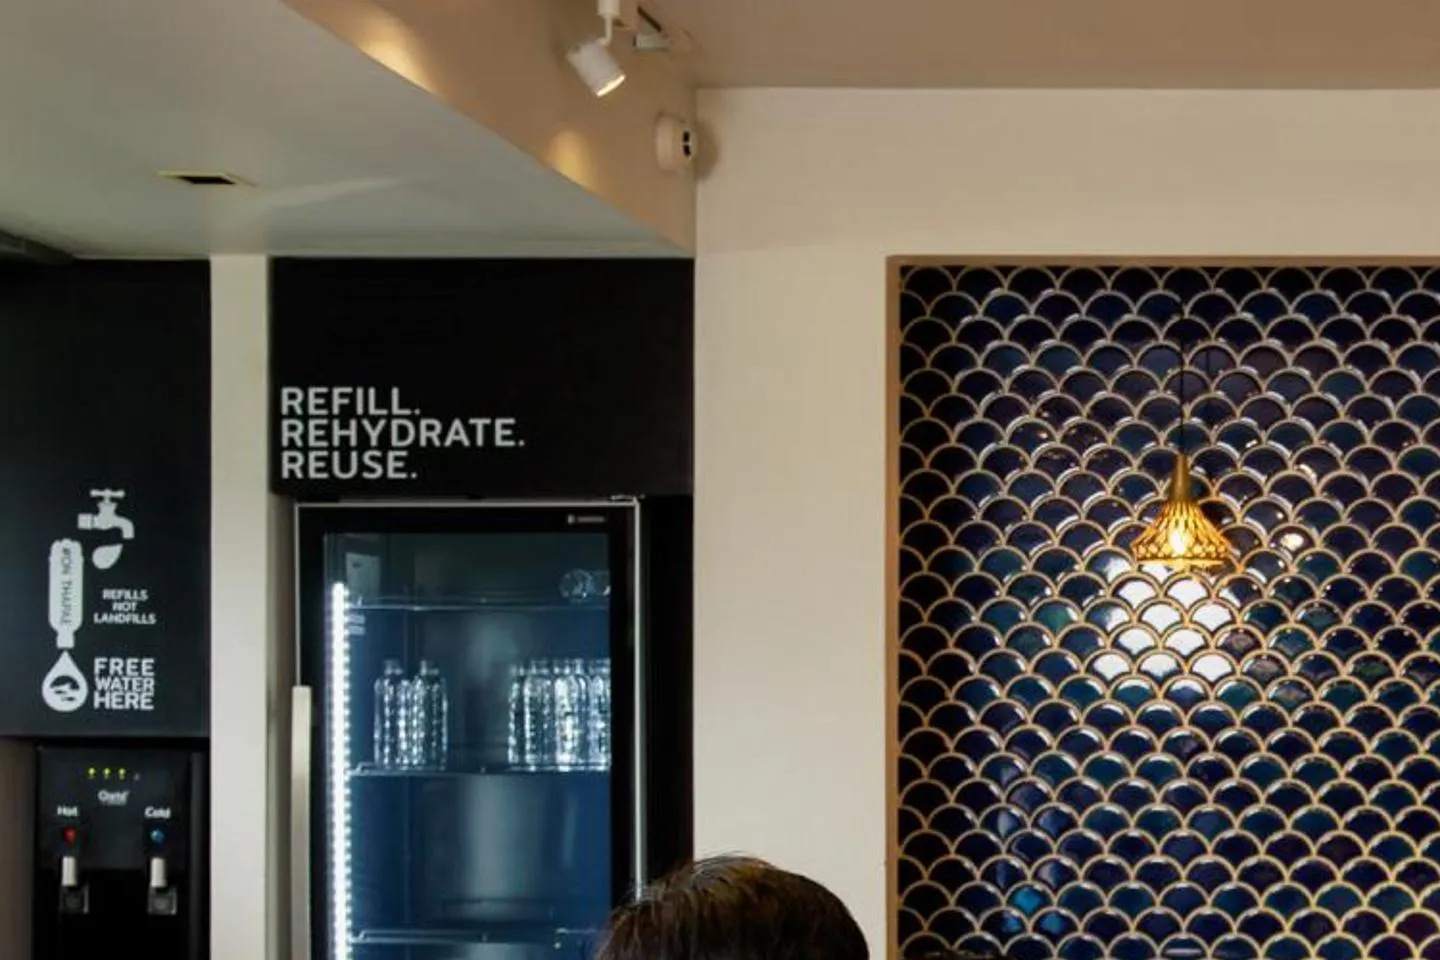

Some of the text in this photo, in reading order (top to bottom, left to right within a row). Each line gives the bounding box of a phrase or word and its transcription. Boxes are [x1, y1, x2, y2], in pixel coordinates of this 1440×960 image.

[281, 386, 421, 416] REFILL.
[281, 418, 525, 448] REHYDRATE.
[281, 450, 417, 479] REUSE.
[102, 589, 149, 601] REFILLS
[112, 601, 138, 612] NOT
[93, 612, 156, 625] LANDFILLS
[93, 658, 155, 677] FREE
[94, 675, 155, 695] WATER
[93, 692, 155, 710] HERE
[144, 806, 171, 819] Cold
